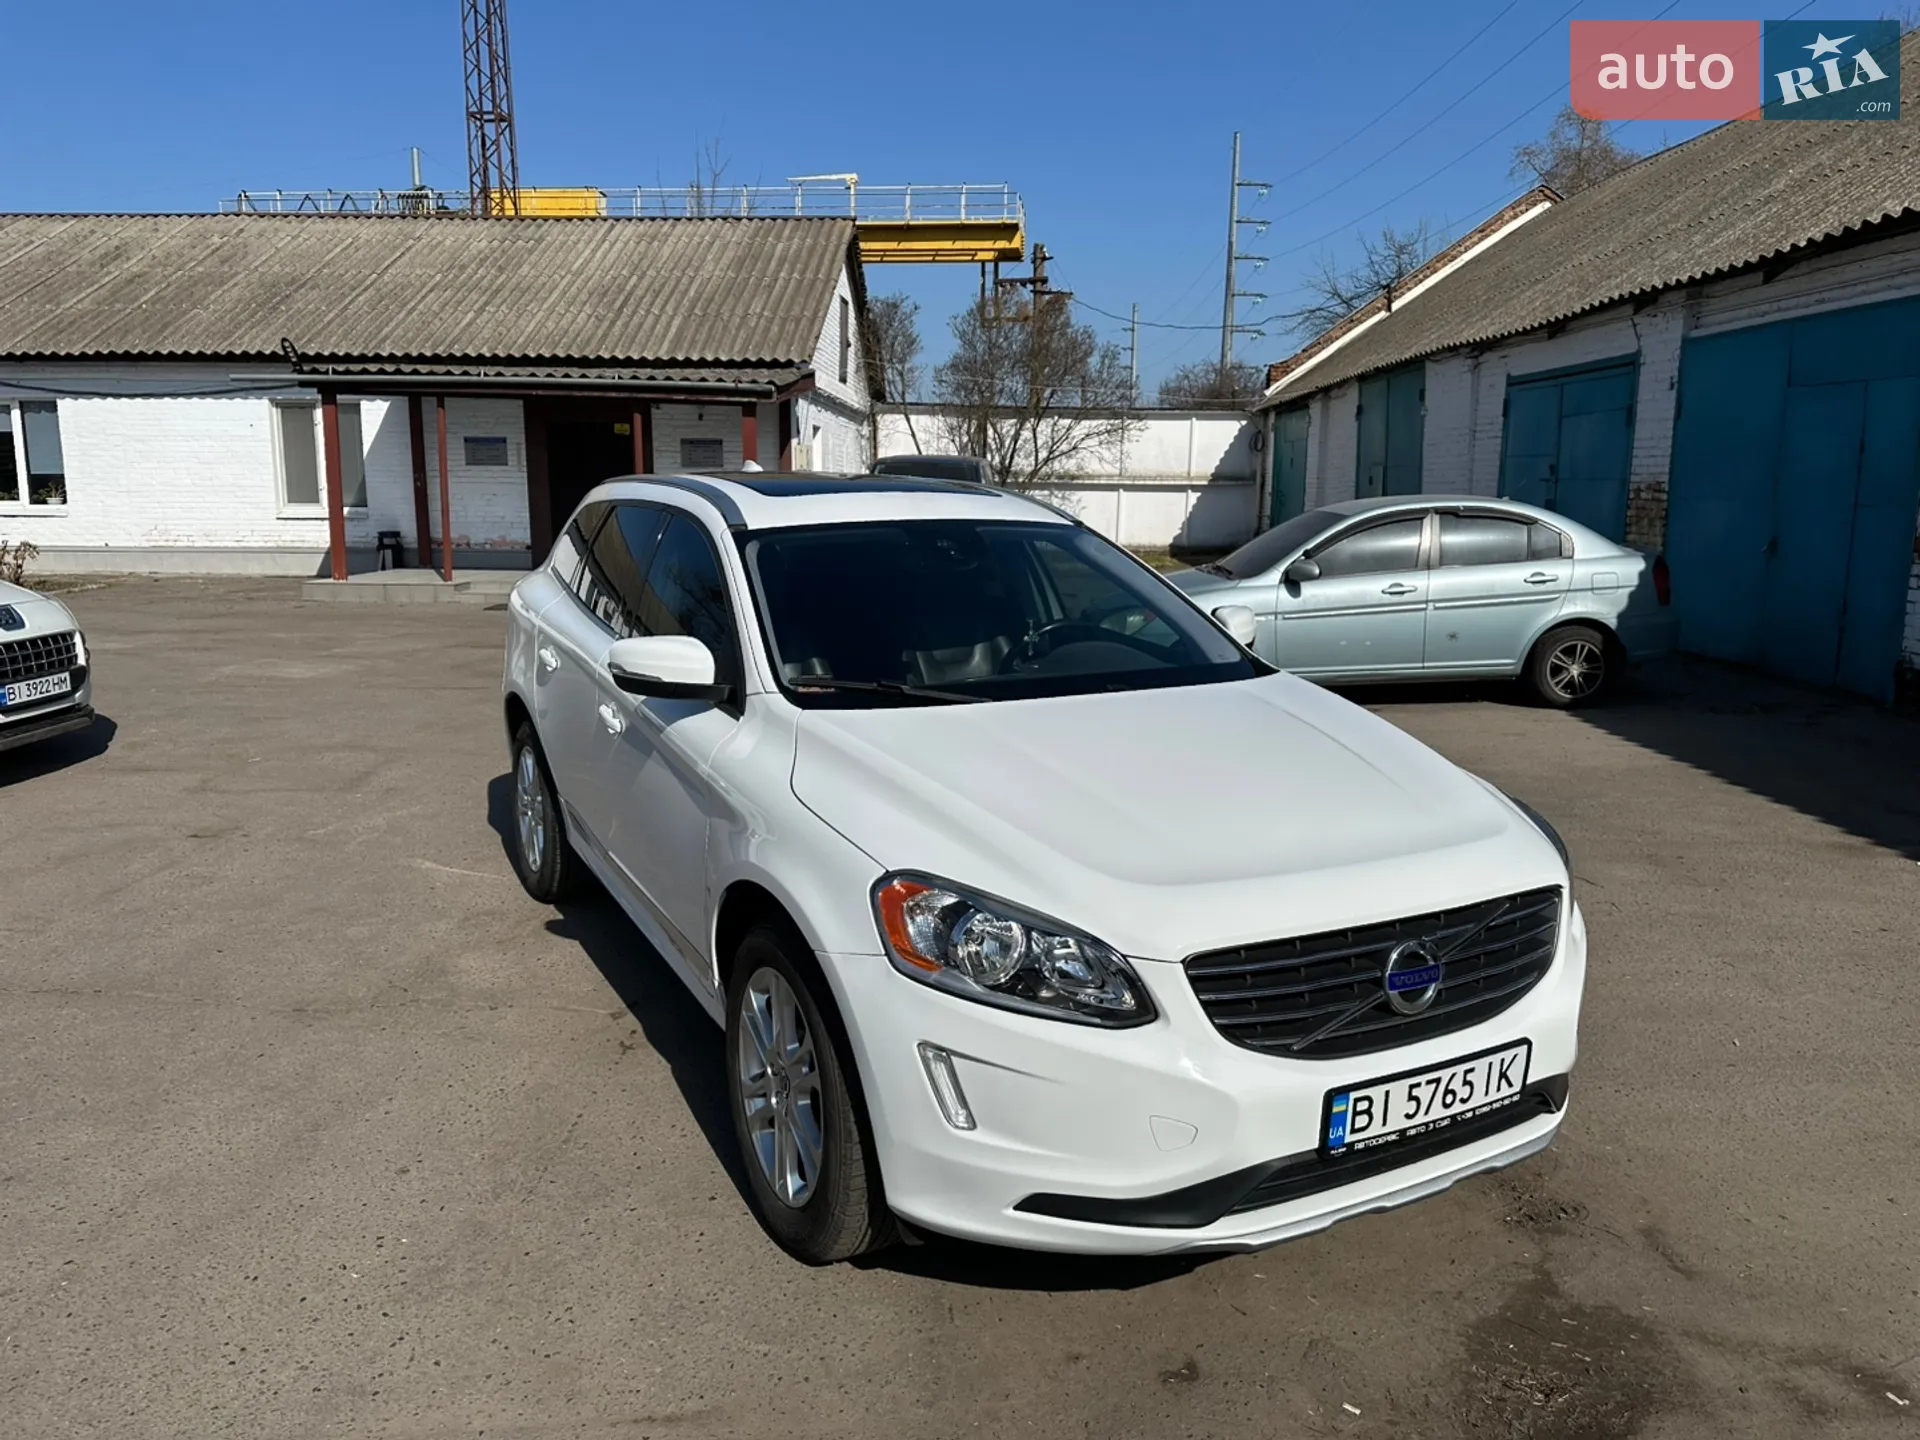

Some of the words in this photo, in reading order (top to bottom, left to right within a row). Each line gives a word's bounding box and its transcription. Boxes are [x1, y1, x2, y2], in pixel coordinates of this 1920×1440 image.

[7, 685, 22, 702] BI
[25, 679, 51, 698] 3922
[52, 674, 68, 692] HM
[1392, 968, 1439, 986] VOLVO
[1350, 1089, 1390, 1135] BI
[1404, 1067, 1475, 1120] 5765
[1484, 1053, 1519, 1098] IK
[1329, 1126, 1344, 1139] UA
